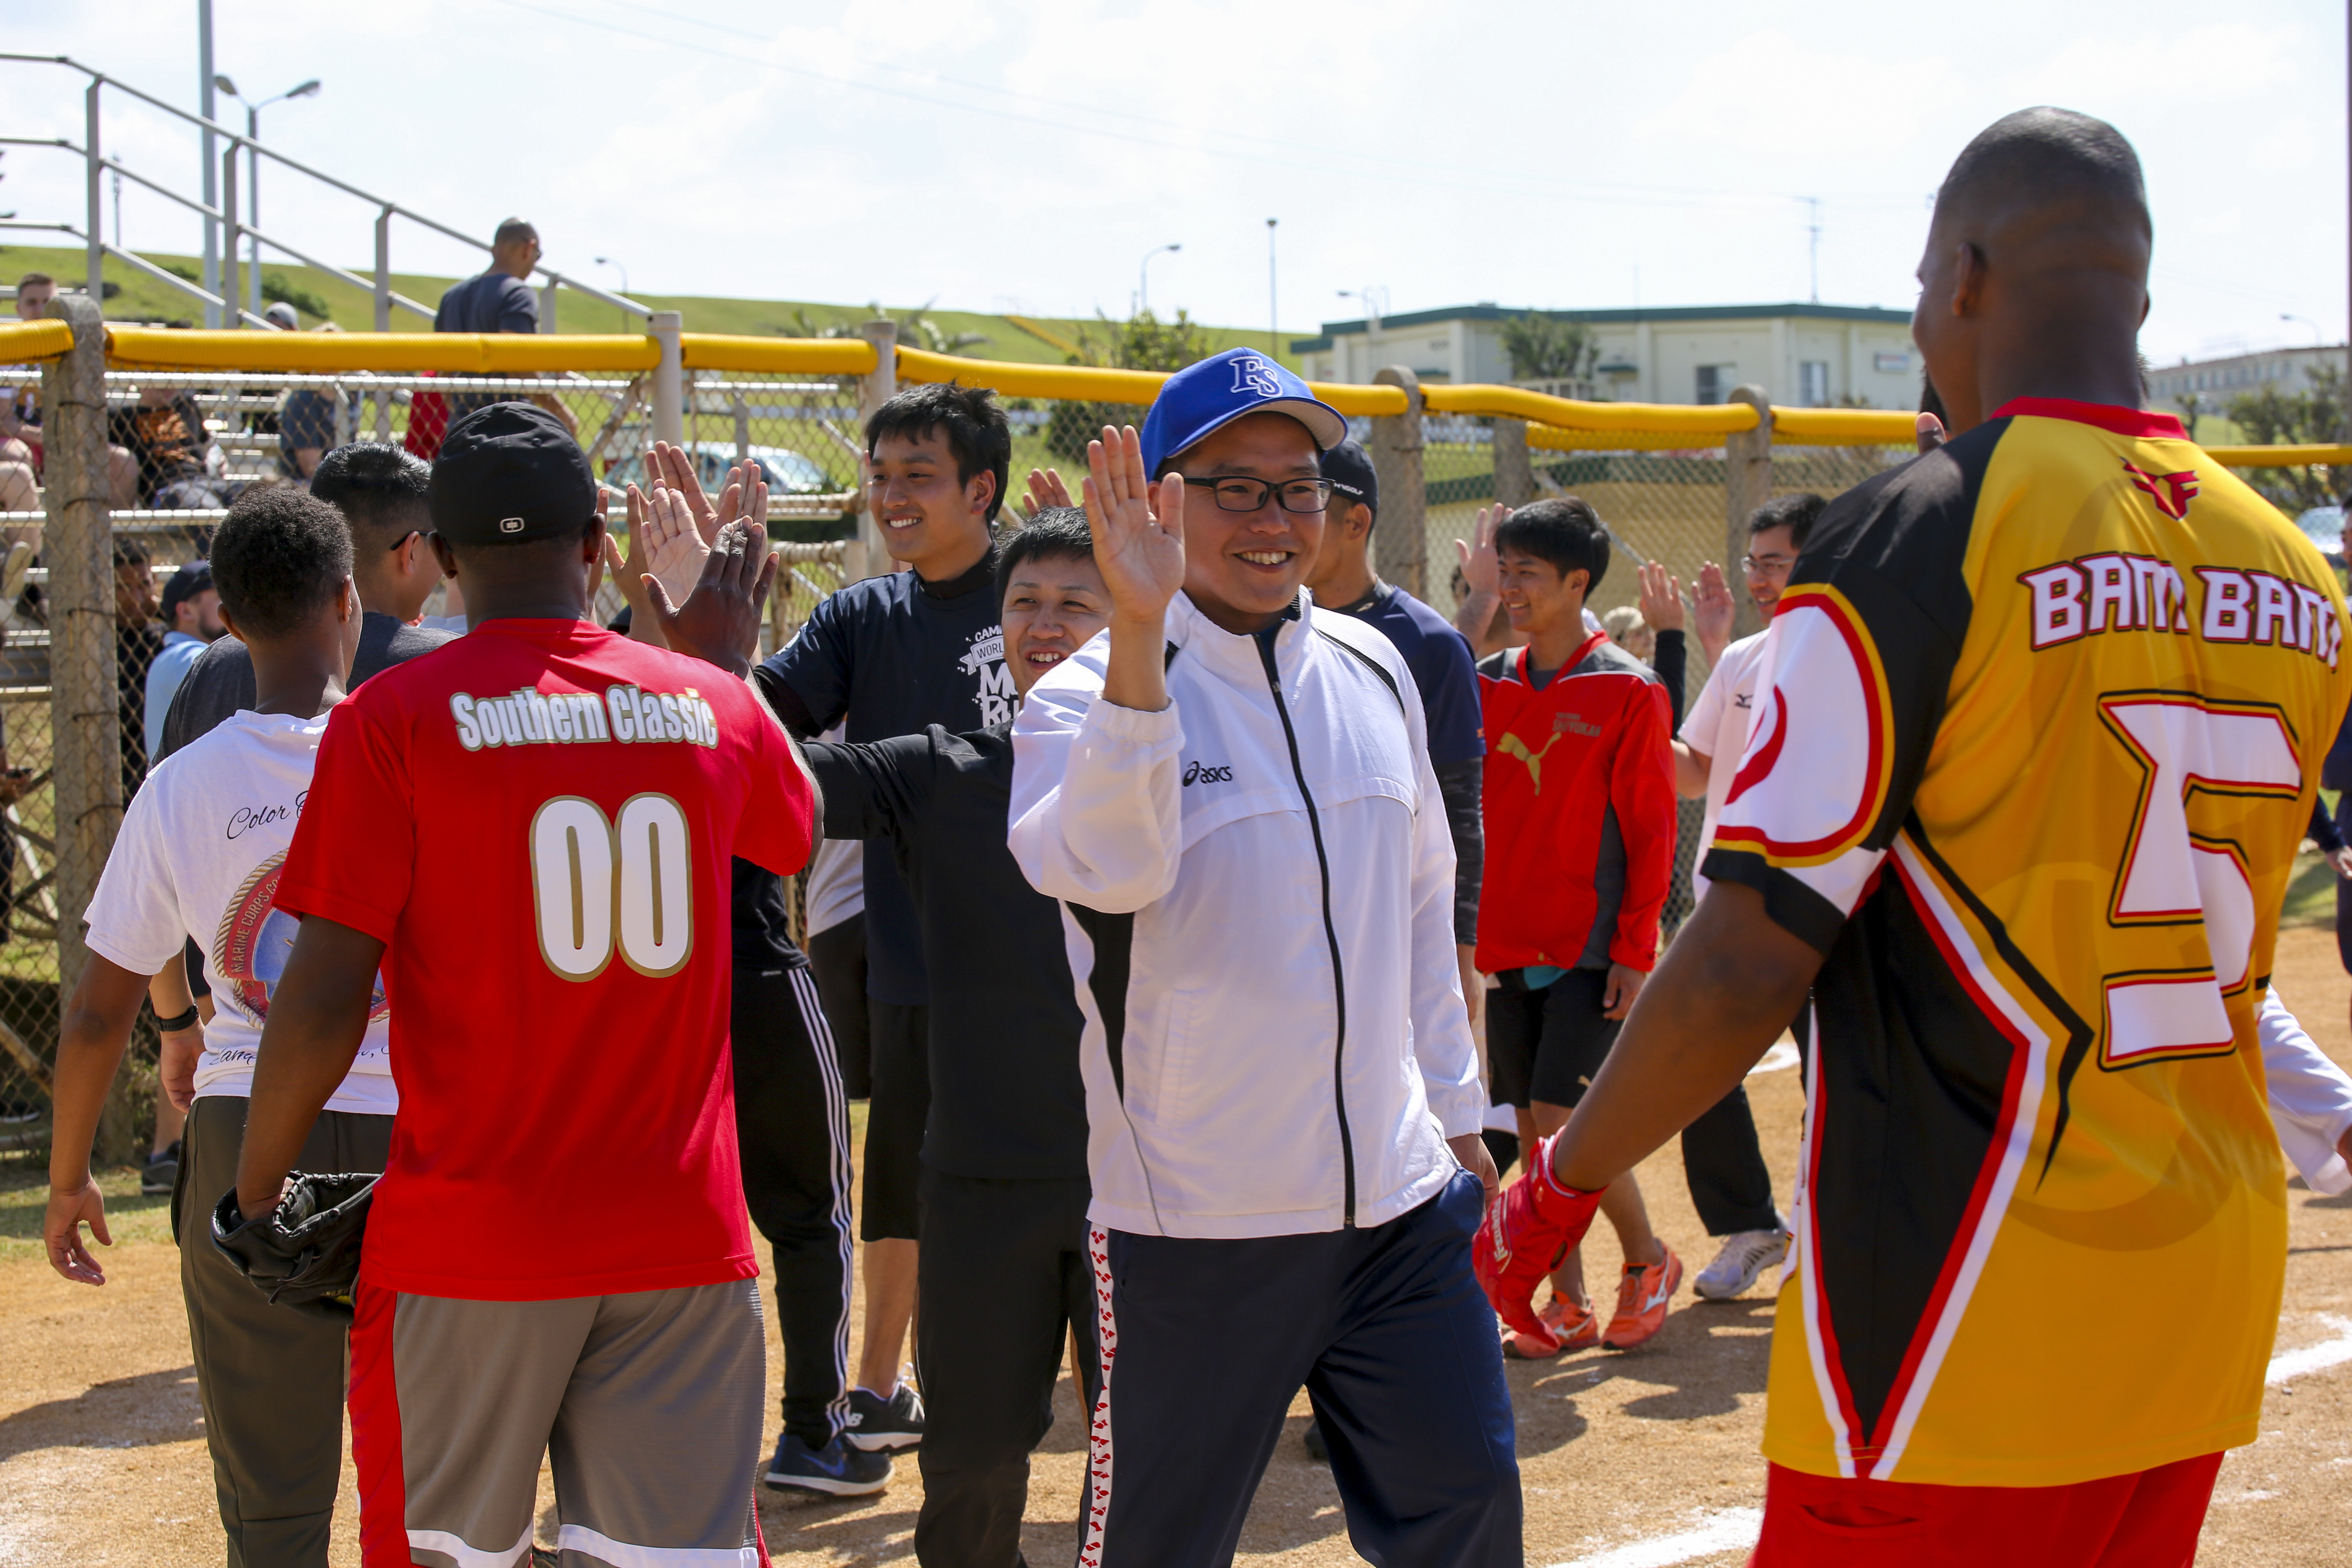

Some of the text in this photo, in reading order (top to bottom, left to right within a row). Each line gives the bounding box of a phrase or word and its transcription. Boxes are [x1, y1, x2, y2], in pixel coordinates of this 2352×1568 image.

[976, 642, 1004, 659] WORL
[2017, 551, 2344, 673] BAM BAM
[449, 683, 718, 751] Southern Classic
[227, 807, 291, 840] Color
[528, 791, 695, 983] 00
[2097, 688, 2303, 1072] 5
[231, 927, 250, 974] MARINE
[241, 891, 270, 927] CORPS
